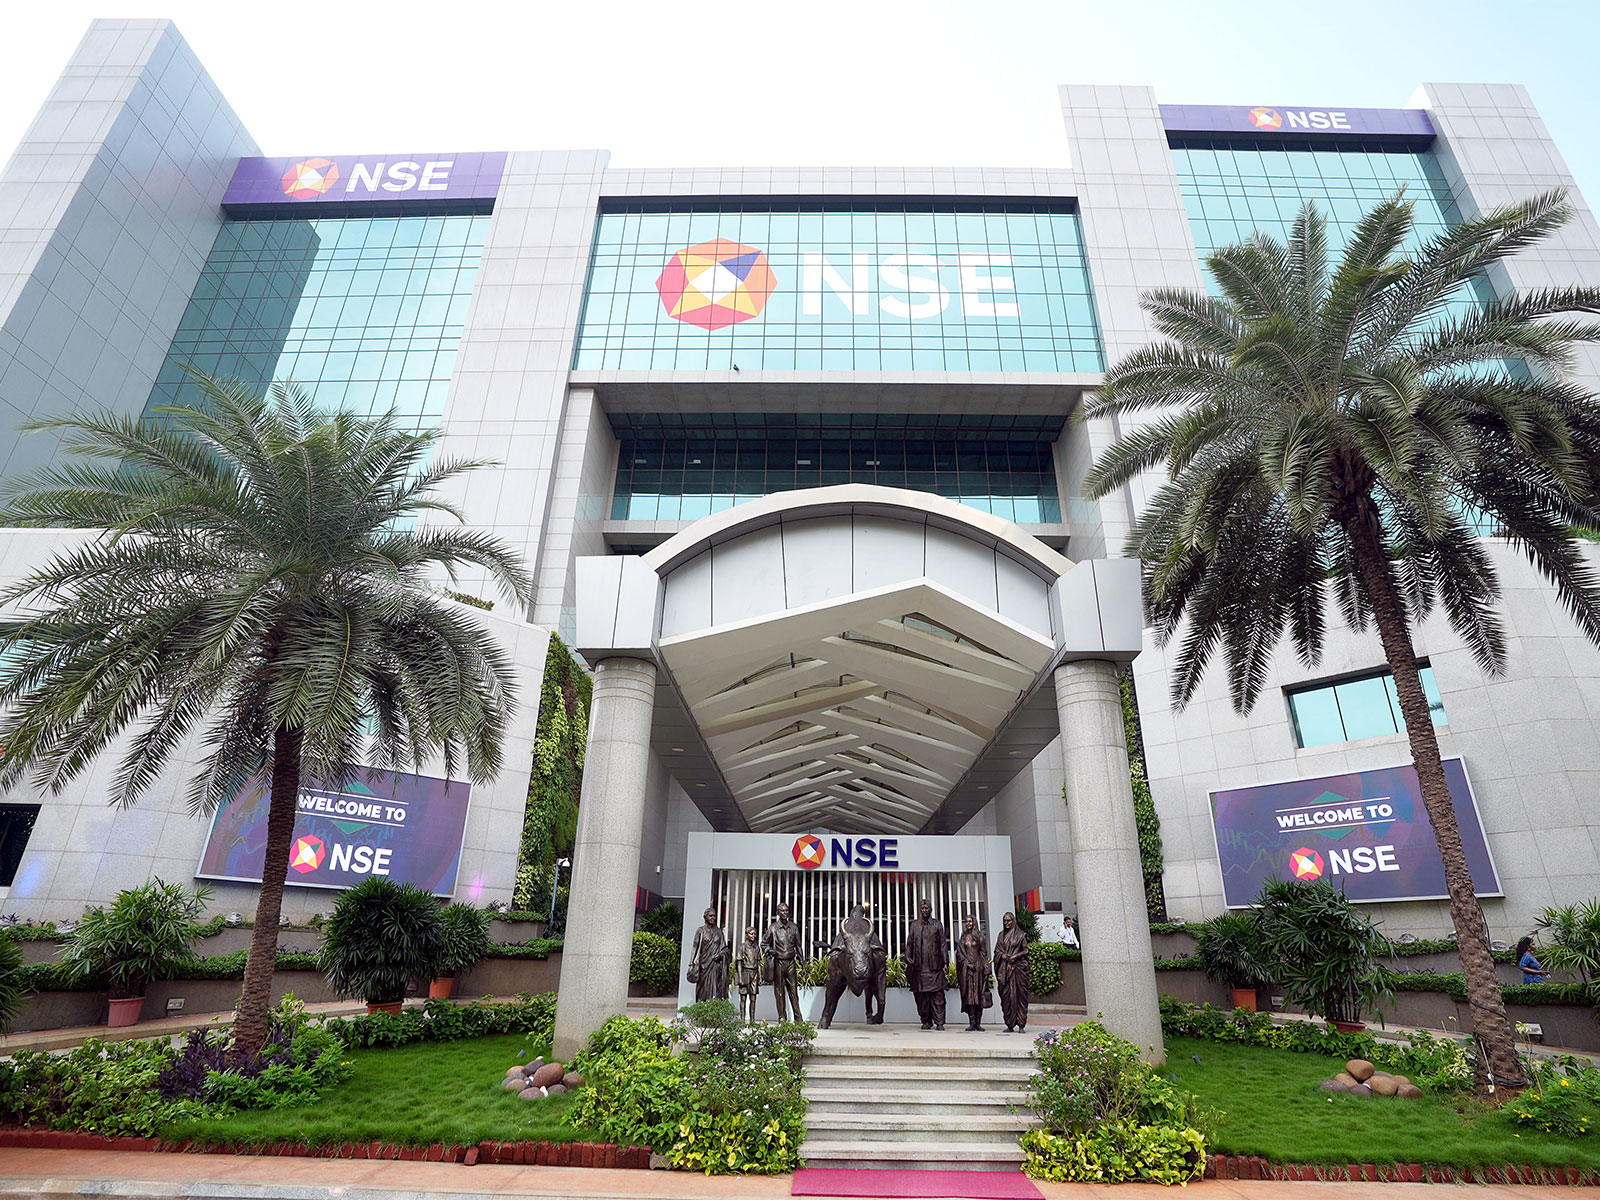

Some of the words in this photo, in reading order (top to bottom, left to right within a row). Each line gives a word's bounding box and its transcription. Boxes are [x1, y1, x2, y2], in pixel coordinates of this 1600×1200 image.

[1286, 111, 1352, 129] NSE
[345, 161, 455, 192] NSE
[802, 252, 1020, 319] NSE
[298, 794, 382, 819] WELCOME
[385, 806, 406, 821] TO
[1275, 806, 1365, 828] WELCOME
[1366, 804, 1394, 819] TO
[328, 843, 393, 876] NSE
[831, 838, 899, 867] NSE
[1328, 845, 1400, 875] NSE
